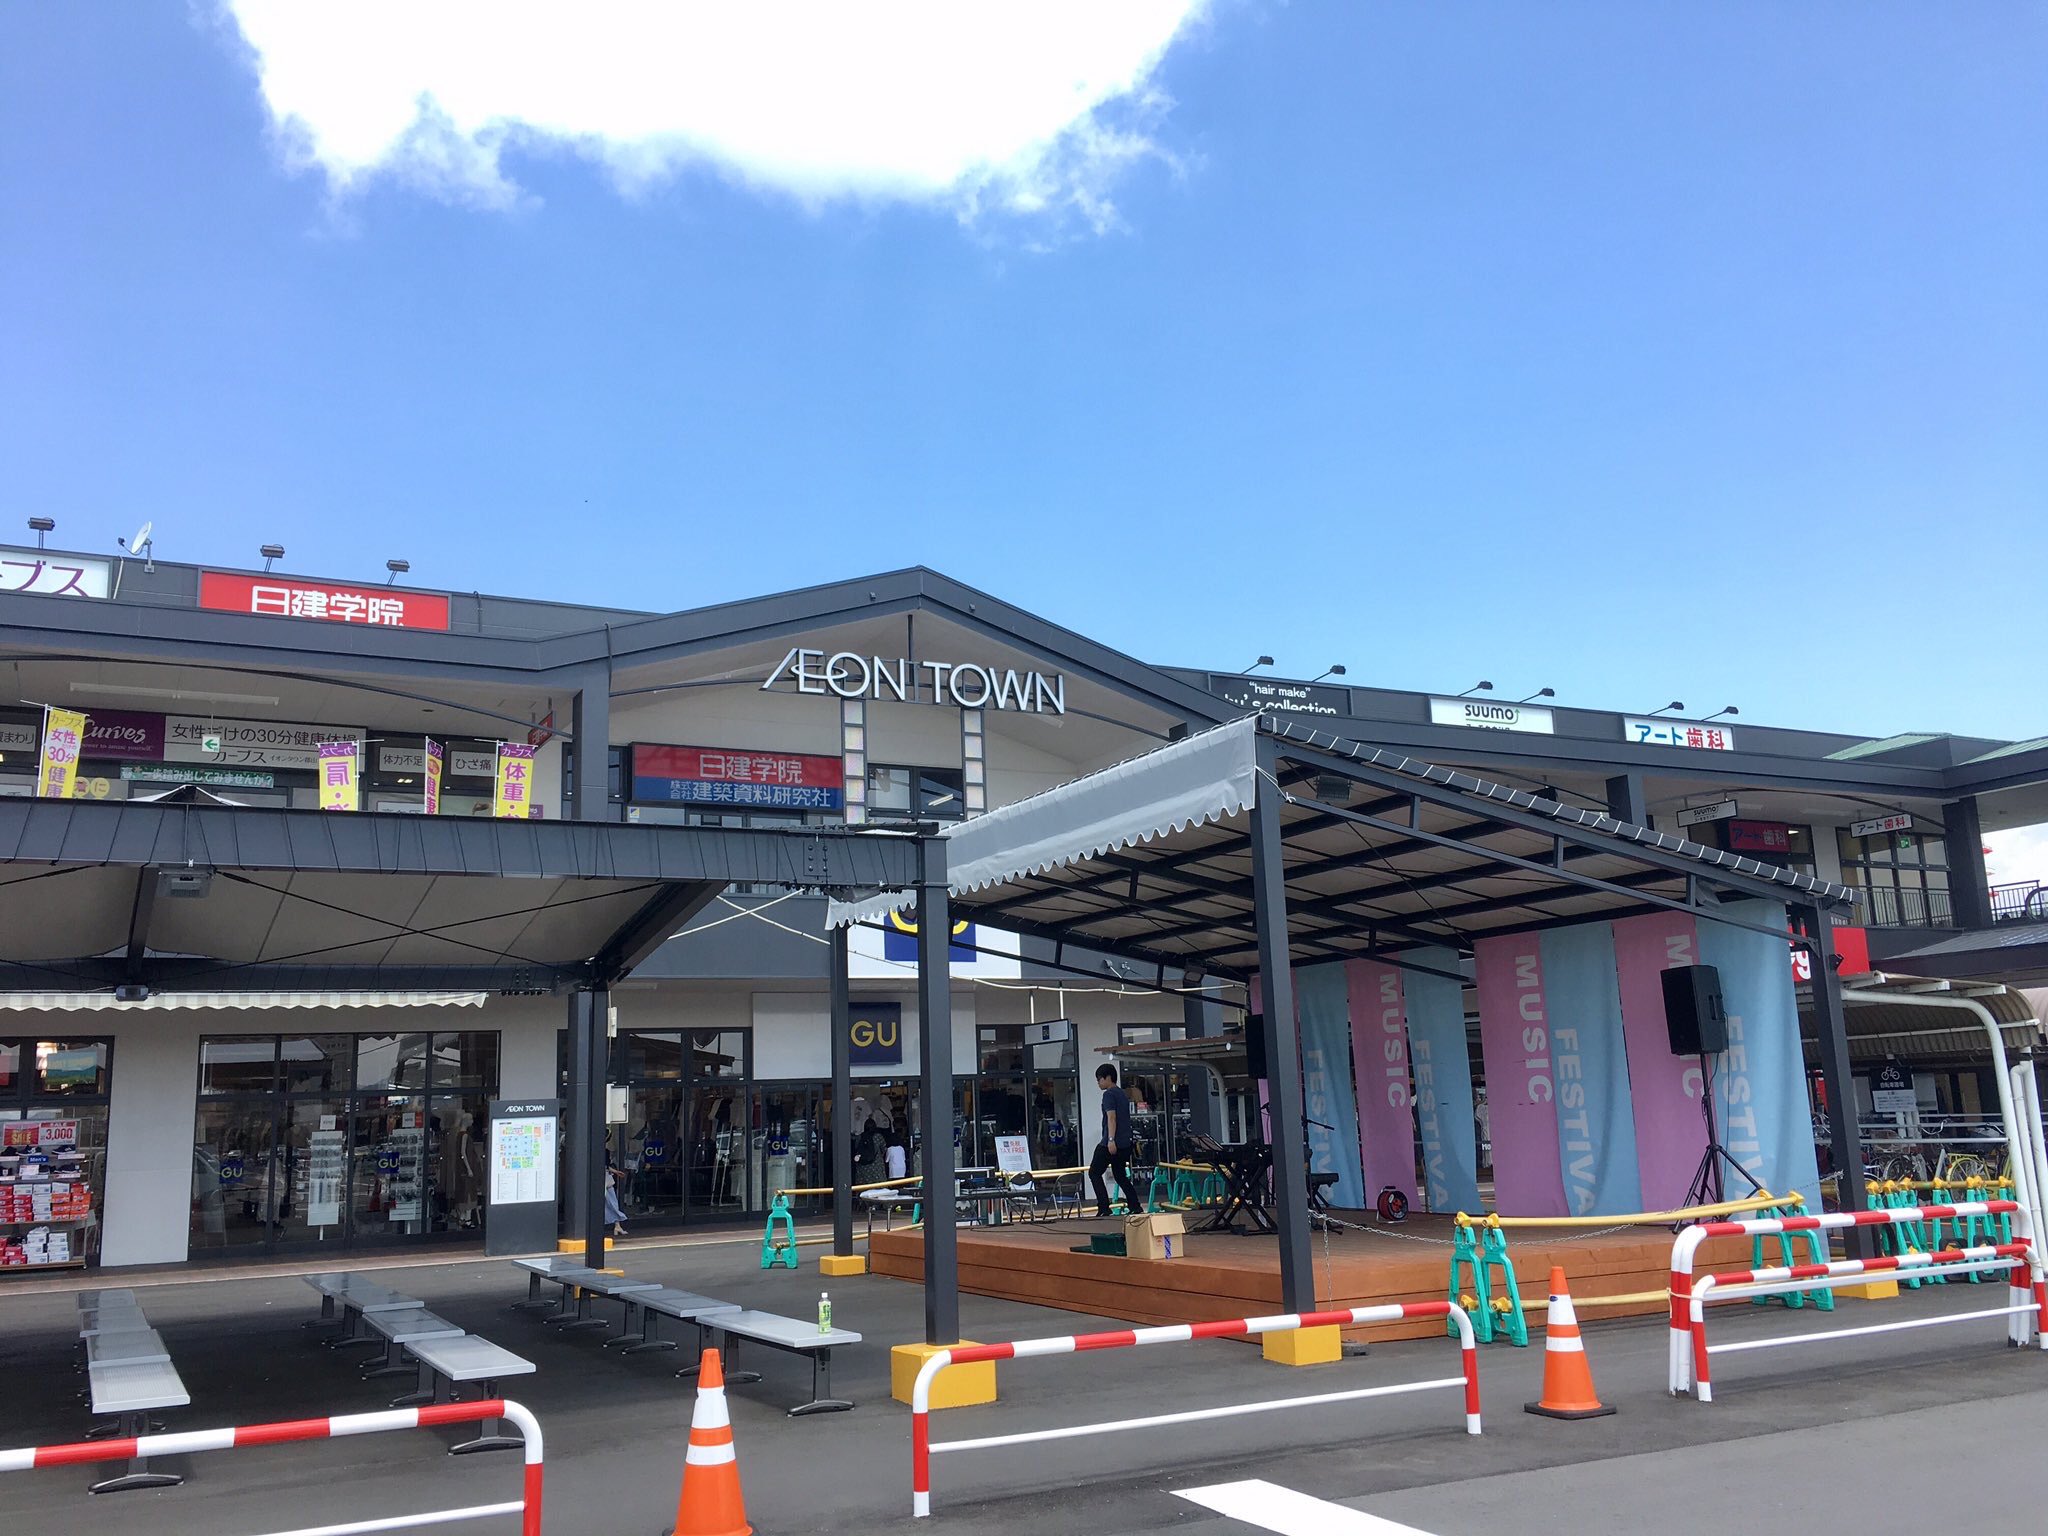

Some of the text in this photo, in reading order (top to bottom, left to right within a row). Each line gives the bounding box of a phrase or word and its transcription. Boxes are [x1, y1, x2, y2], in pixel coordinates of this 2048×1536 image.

[0, 560, 89, 597] ブス
[251, 585, 405, 627] 日建学院
[922, 661, 1065, 715] TOWN
[50, 729, 77, 745] 女性
[83, 719, 147, 744] Curves
[1634, 724, 1725, 750] アート歯科
[47, 746, 77, 763] 30分
[212, 750, 267, 764] カーブス
[383, 755, 423, 767] 体力不足
[502, 748, 532, 758] カーブス
[455, 758, 492, 771] ひざ痛
[700, 754, 803, 784] 日建学院
[46, 765, 67, 798] 健康
[692, 781, 831, 807] 建築資料研究社
[1857, 816, 1906, 834] アート歯科
[850, 1020, 897, 1047] GU
[1515, 955, 1553, 1103] MUSIC
[1380, 973, 1407, 1108] MUSIC
[1414, 1040, 1449, 1208] FESTIVA
[46, 1128, 73, 1140] 3,000
[1049, 1129, 1063, 1139] GU
[645, 1146, 664, 1157] GU
[771, 1140, 788, 1151] GU
[221, 1167, 243, 1178] GU
[378, 1158, 399, 1169] GU
